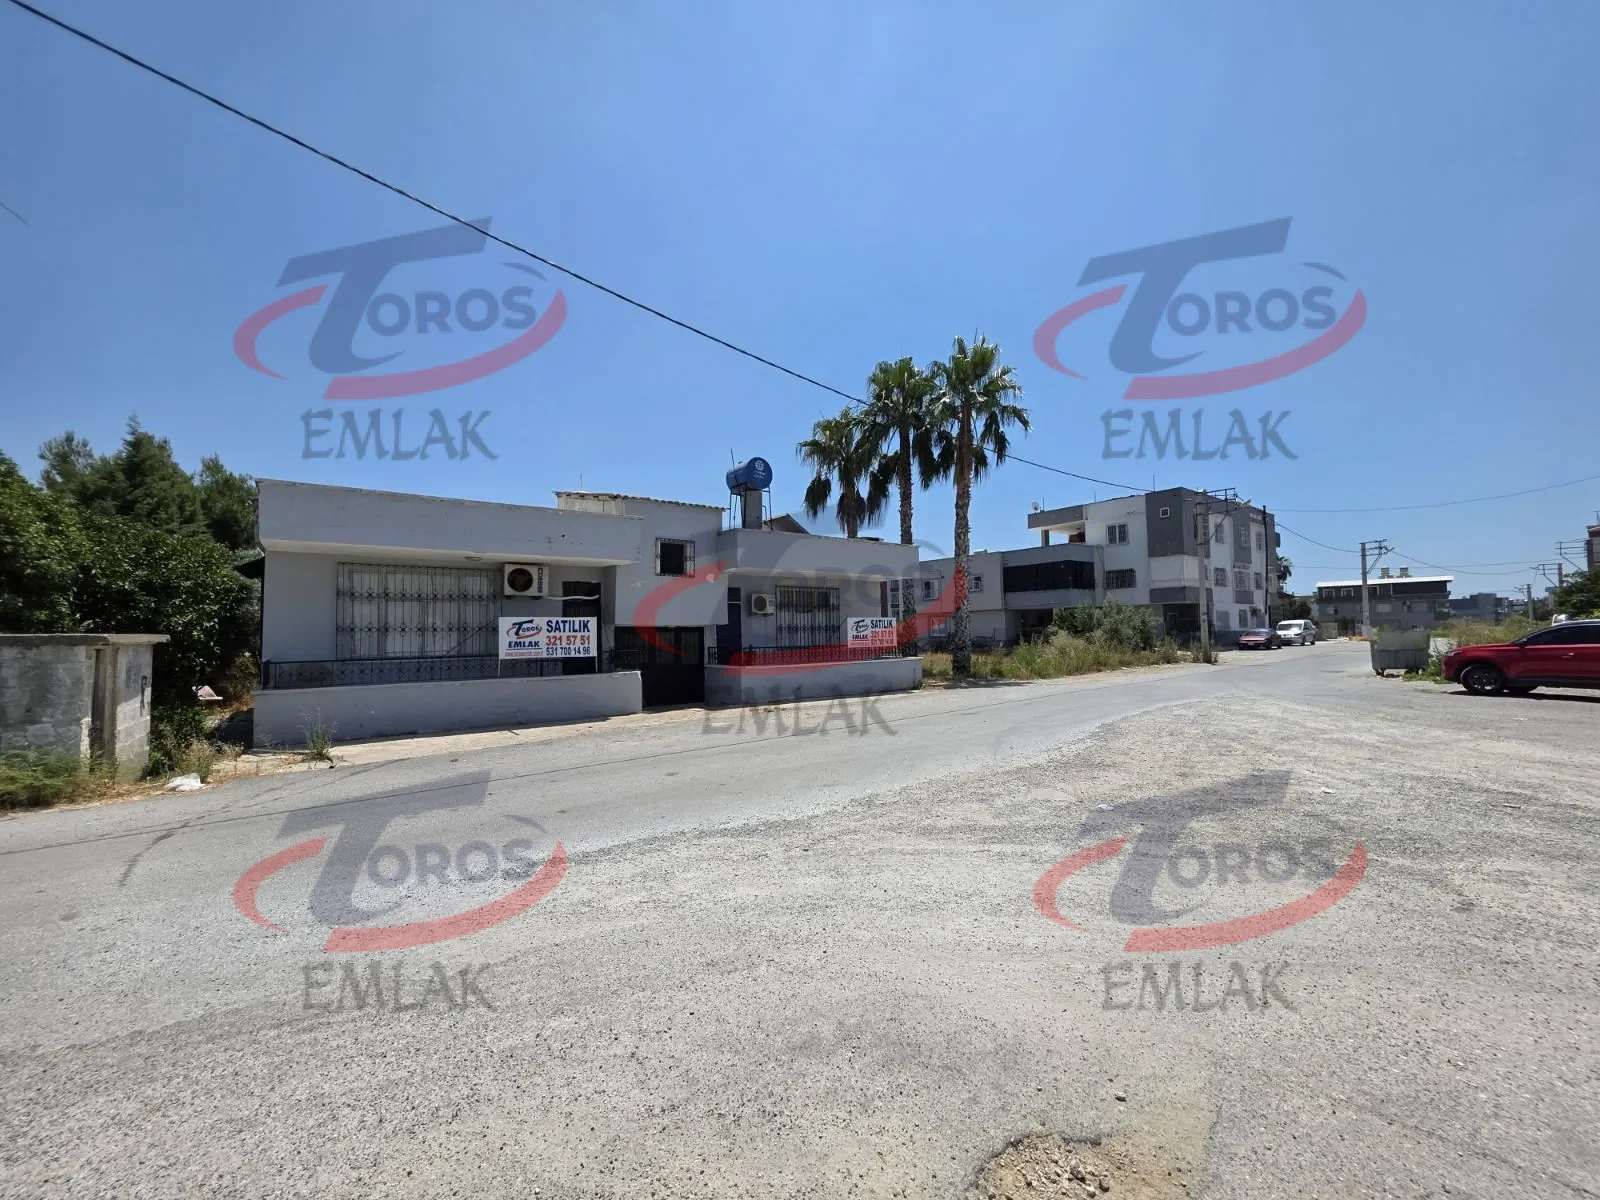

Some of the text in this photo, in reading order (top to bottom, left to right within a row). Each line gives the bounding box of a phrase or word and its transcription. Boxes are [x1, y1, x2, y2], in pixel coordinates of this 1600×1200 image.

[512, 619, 539, 636] TOROS
[546, 620, 590, 633] SATILIK
[870, 620, 893, 628] SATILIK
[508, 640, 540, 648] EMLAK
[546, 634, 591, 646] 321 57 51
[546, 646, 558, 656] 531
[559, 646, 572, 655] 700
[573, 645, 581, 655] 14
